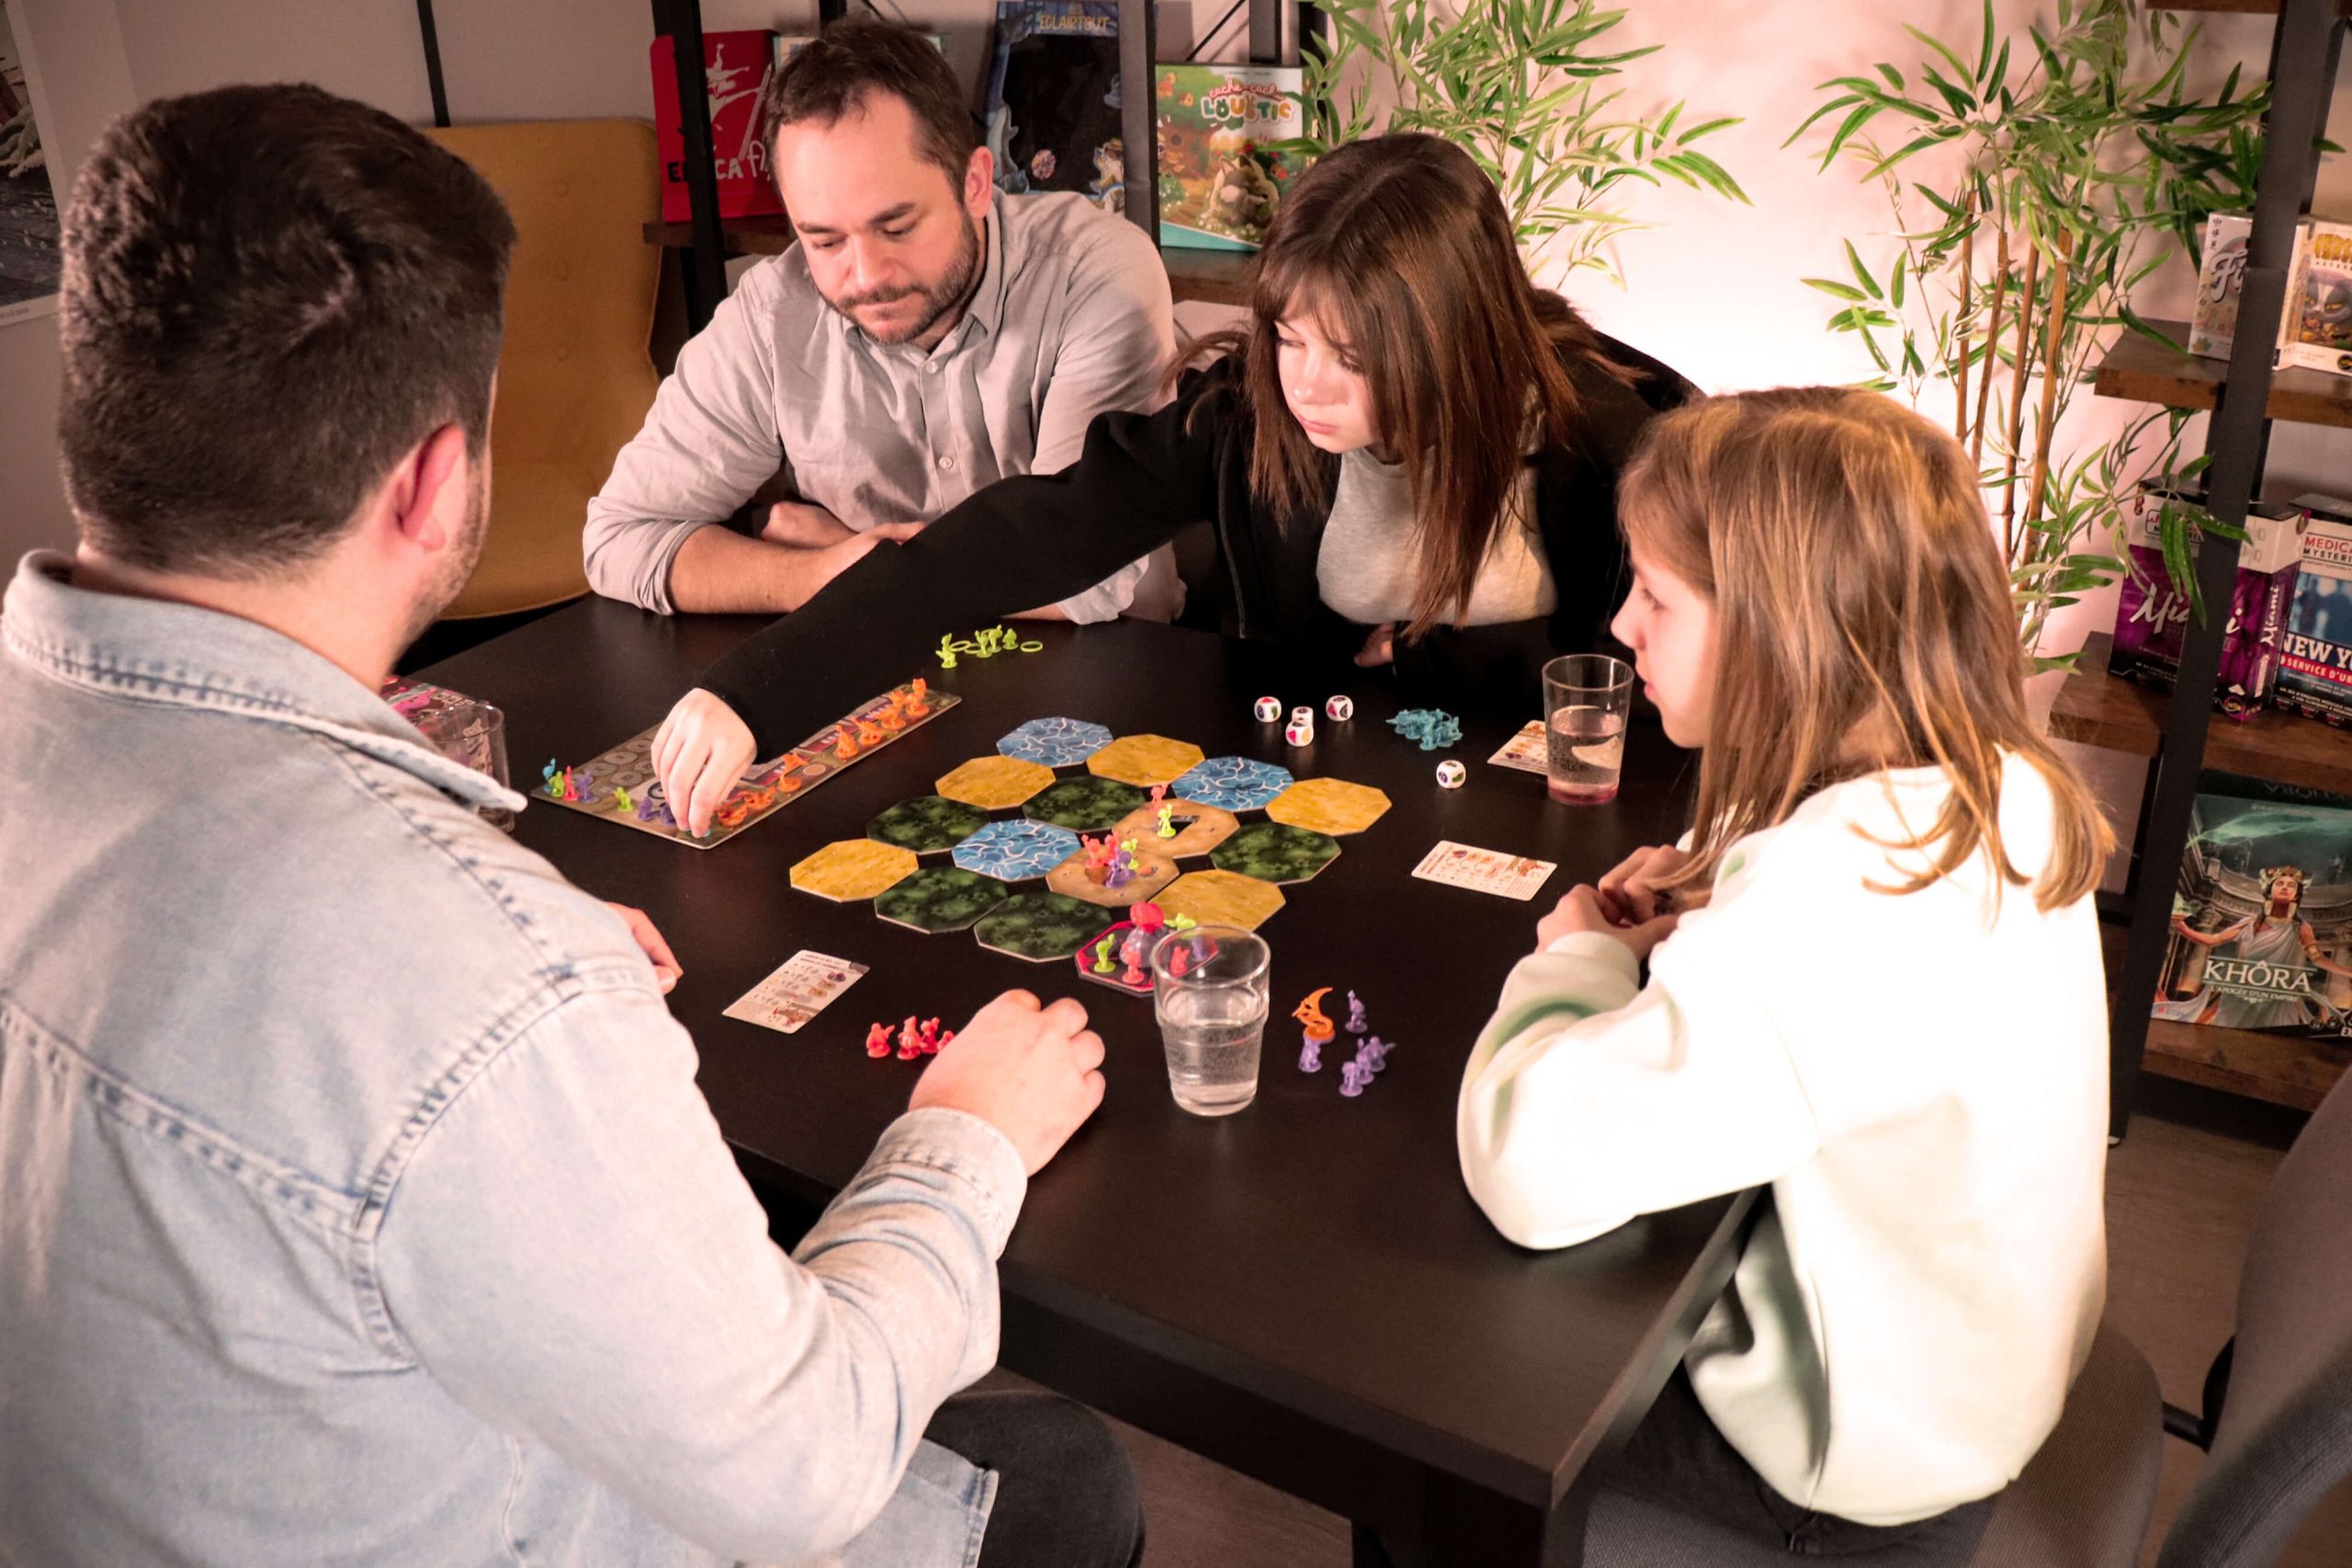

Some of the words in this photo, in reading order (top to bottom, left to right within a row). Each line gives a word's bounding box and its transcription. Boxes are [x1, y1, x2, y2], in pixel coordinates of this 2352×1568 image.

[1201, 93, 1295, 121] LOUSTIC
[2283, 633, 2334, 662] NEW
[2287, 659, 2327, 676] SERVICE
[2203, 960, 2312, 992] KHÔRA
